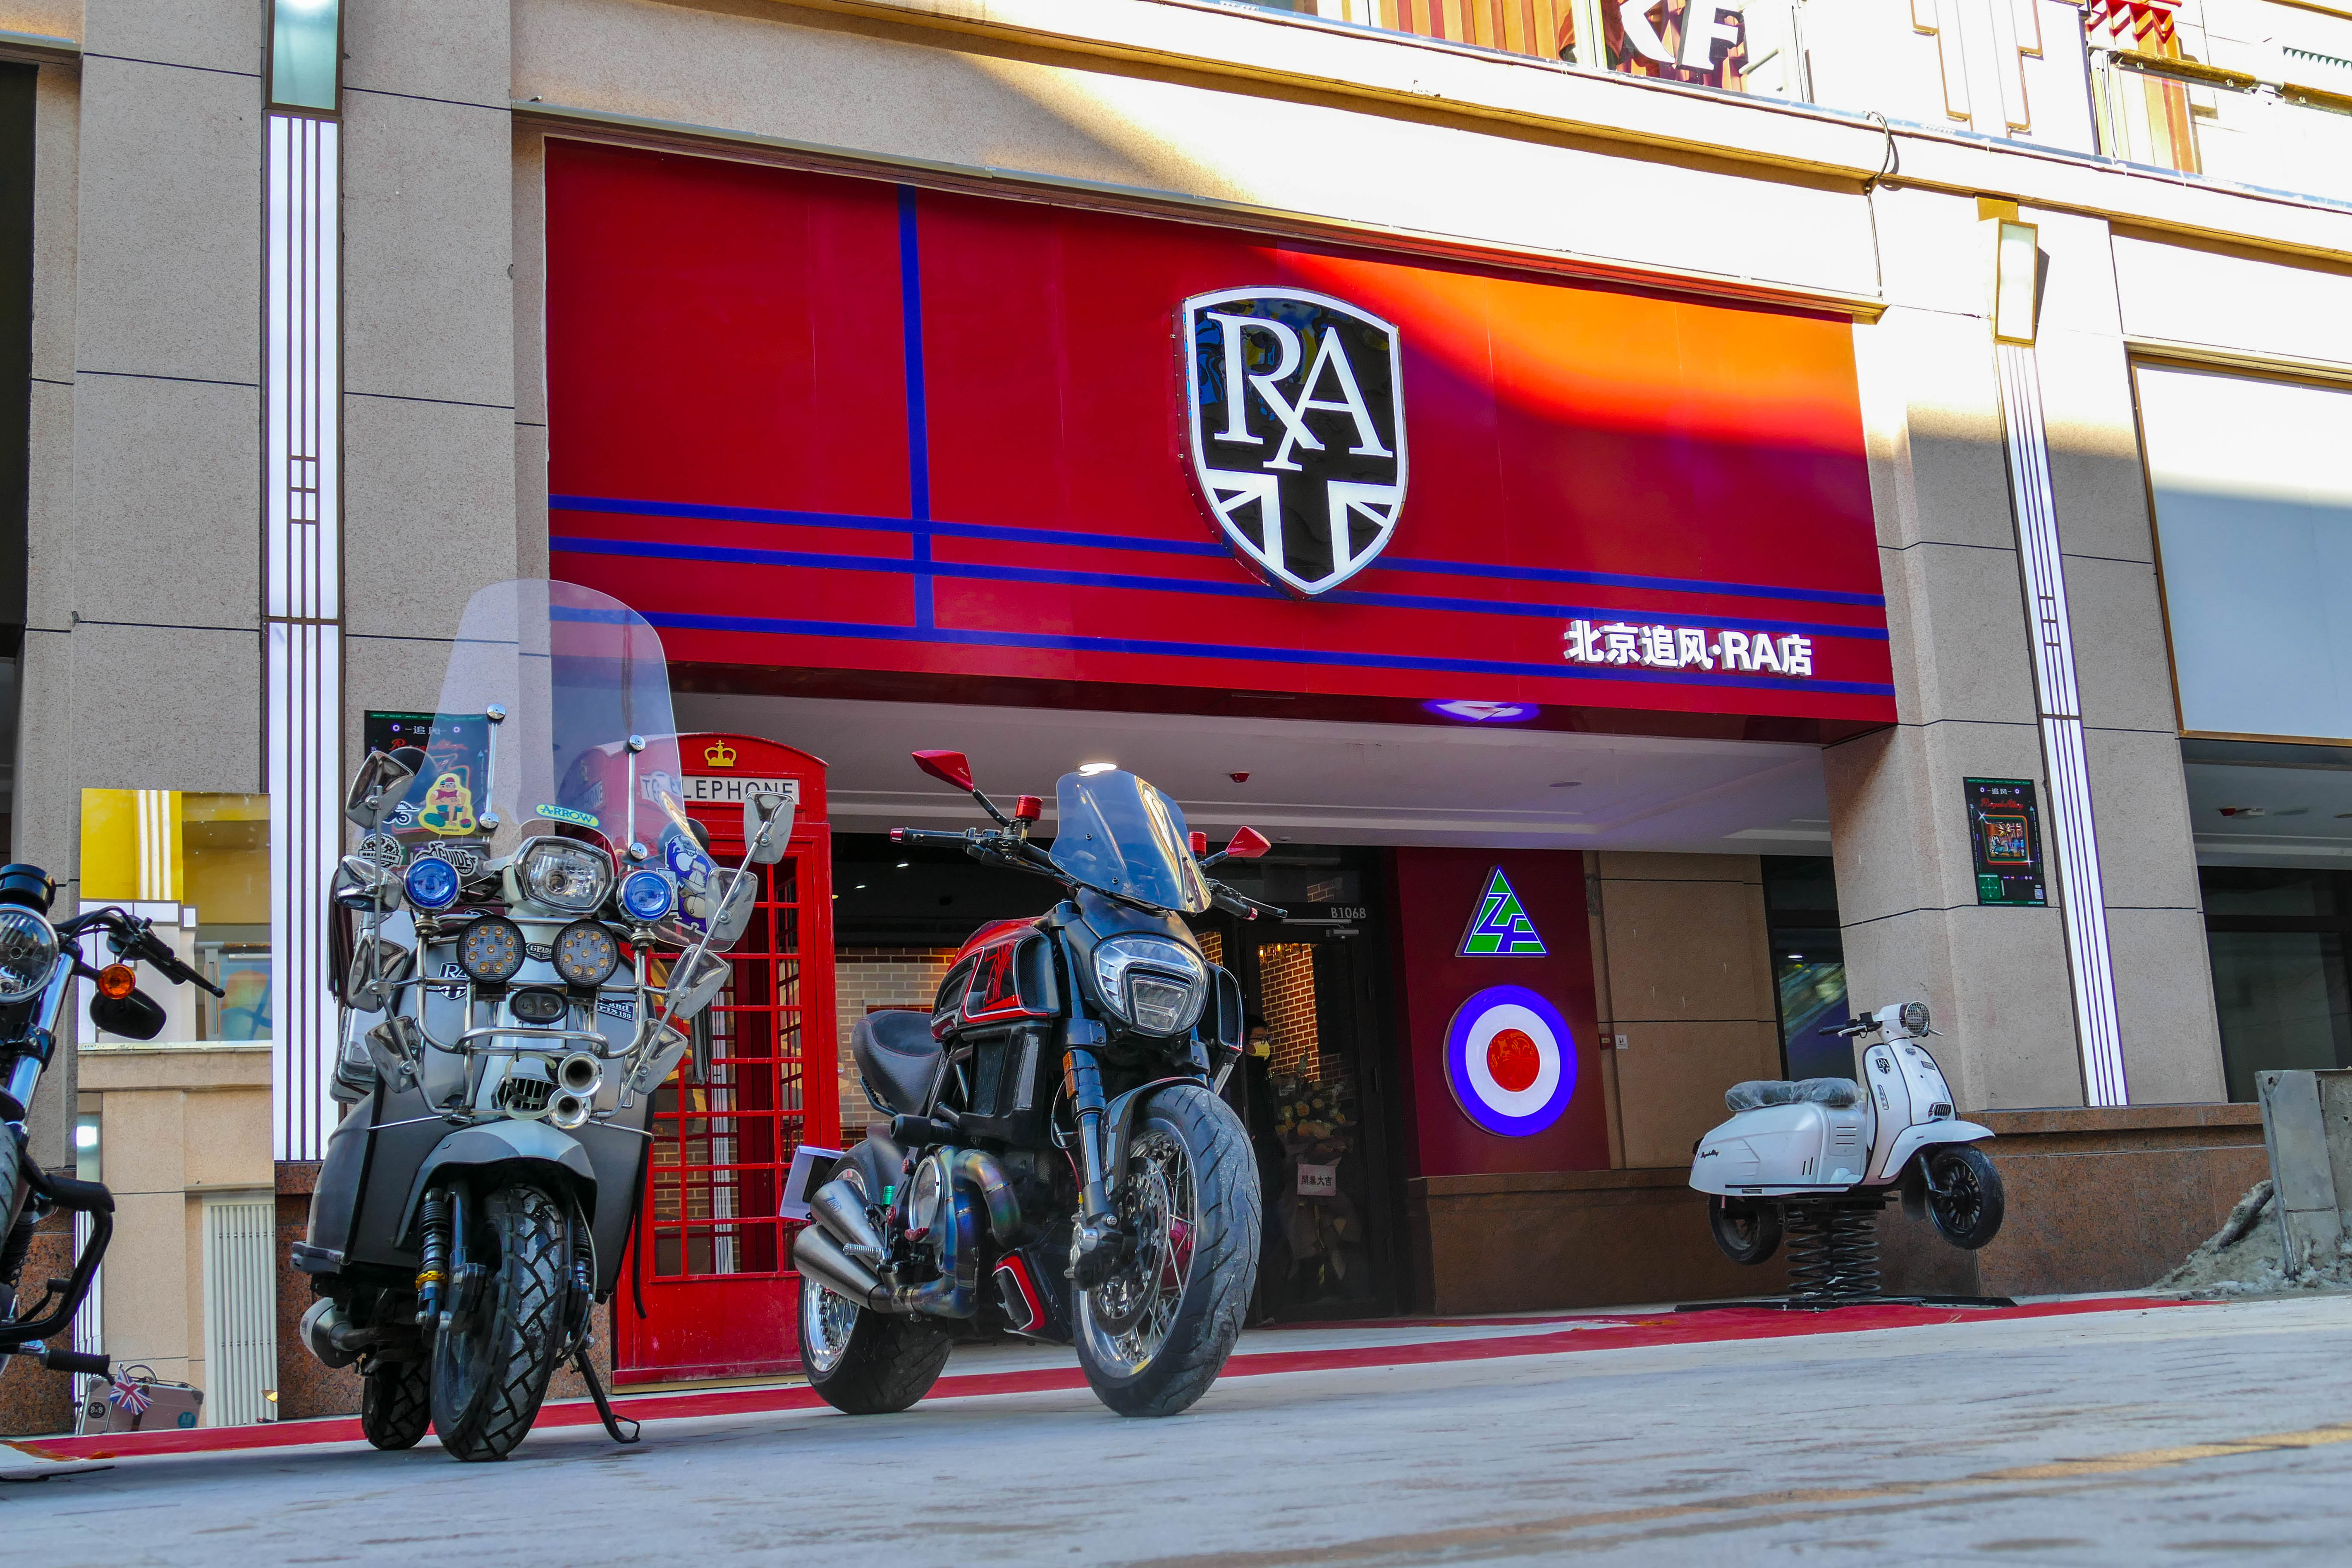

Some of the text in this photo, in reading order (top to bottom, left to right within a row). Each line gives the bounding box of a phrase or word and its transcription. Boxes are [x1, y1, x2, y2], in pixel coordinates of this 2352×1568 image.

[1207, 312, 1393, 471] RA
[540, 805, 593, 822] ARROW
[1331, 907, 1366, 918] B1068
